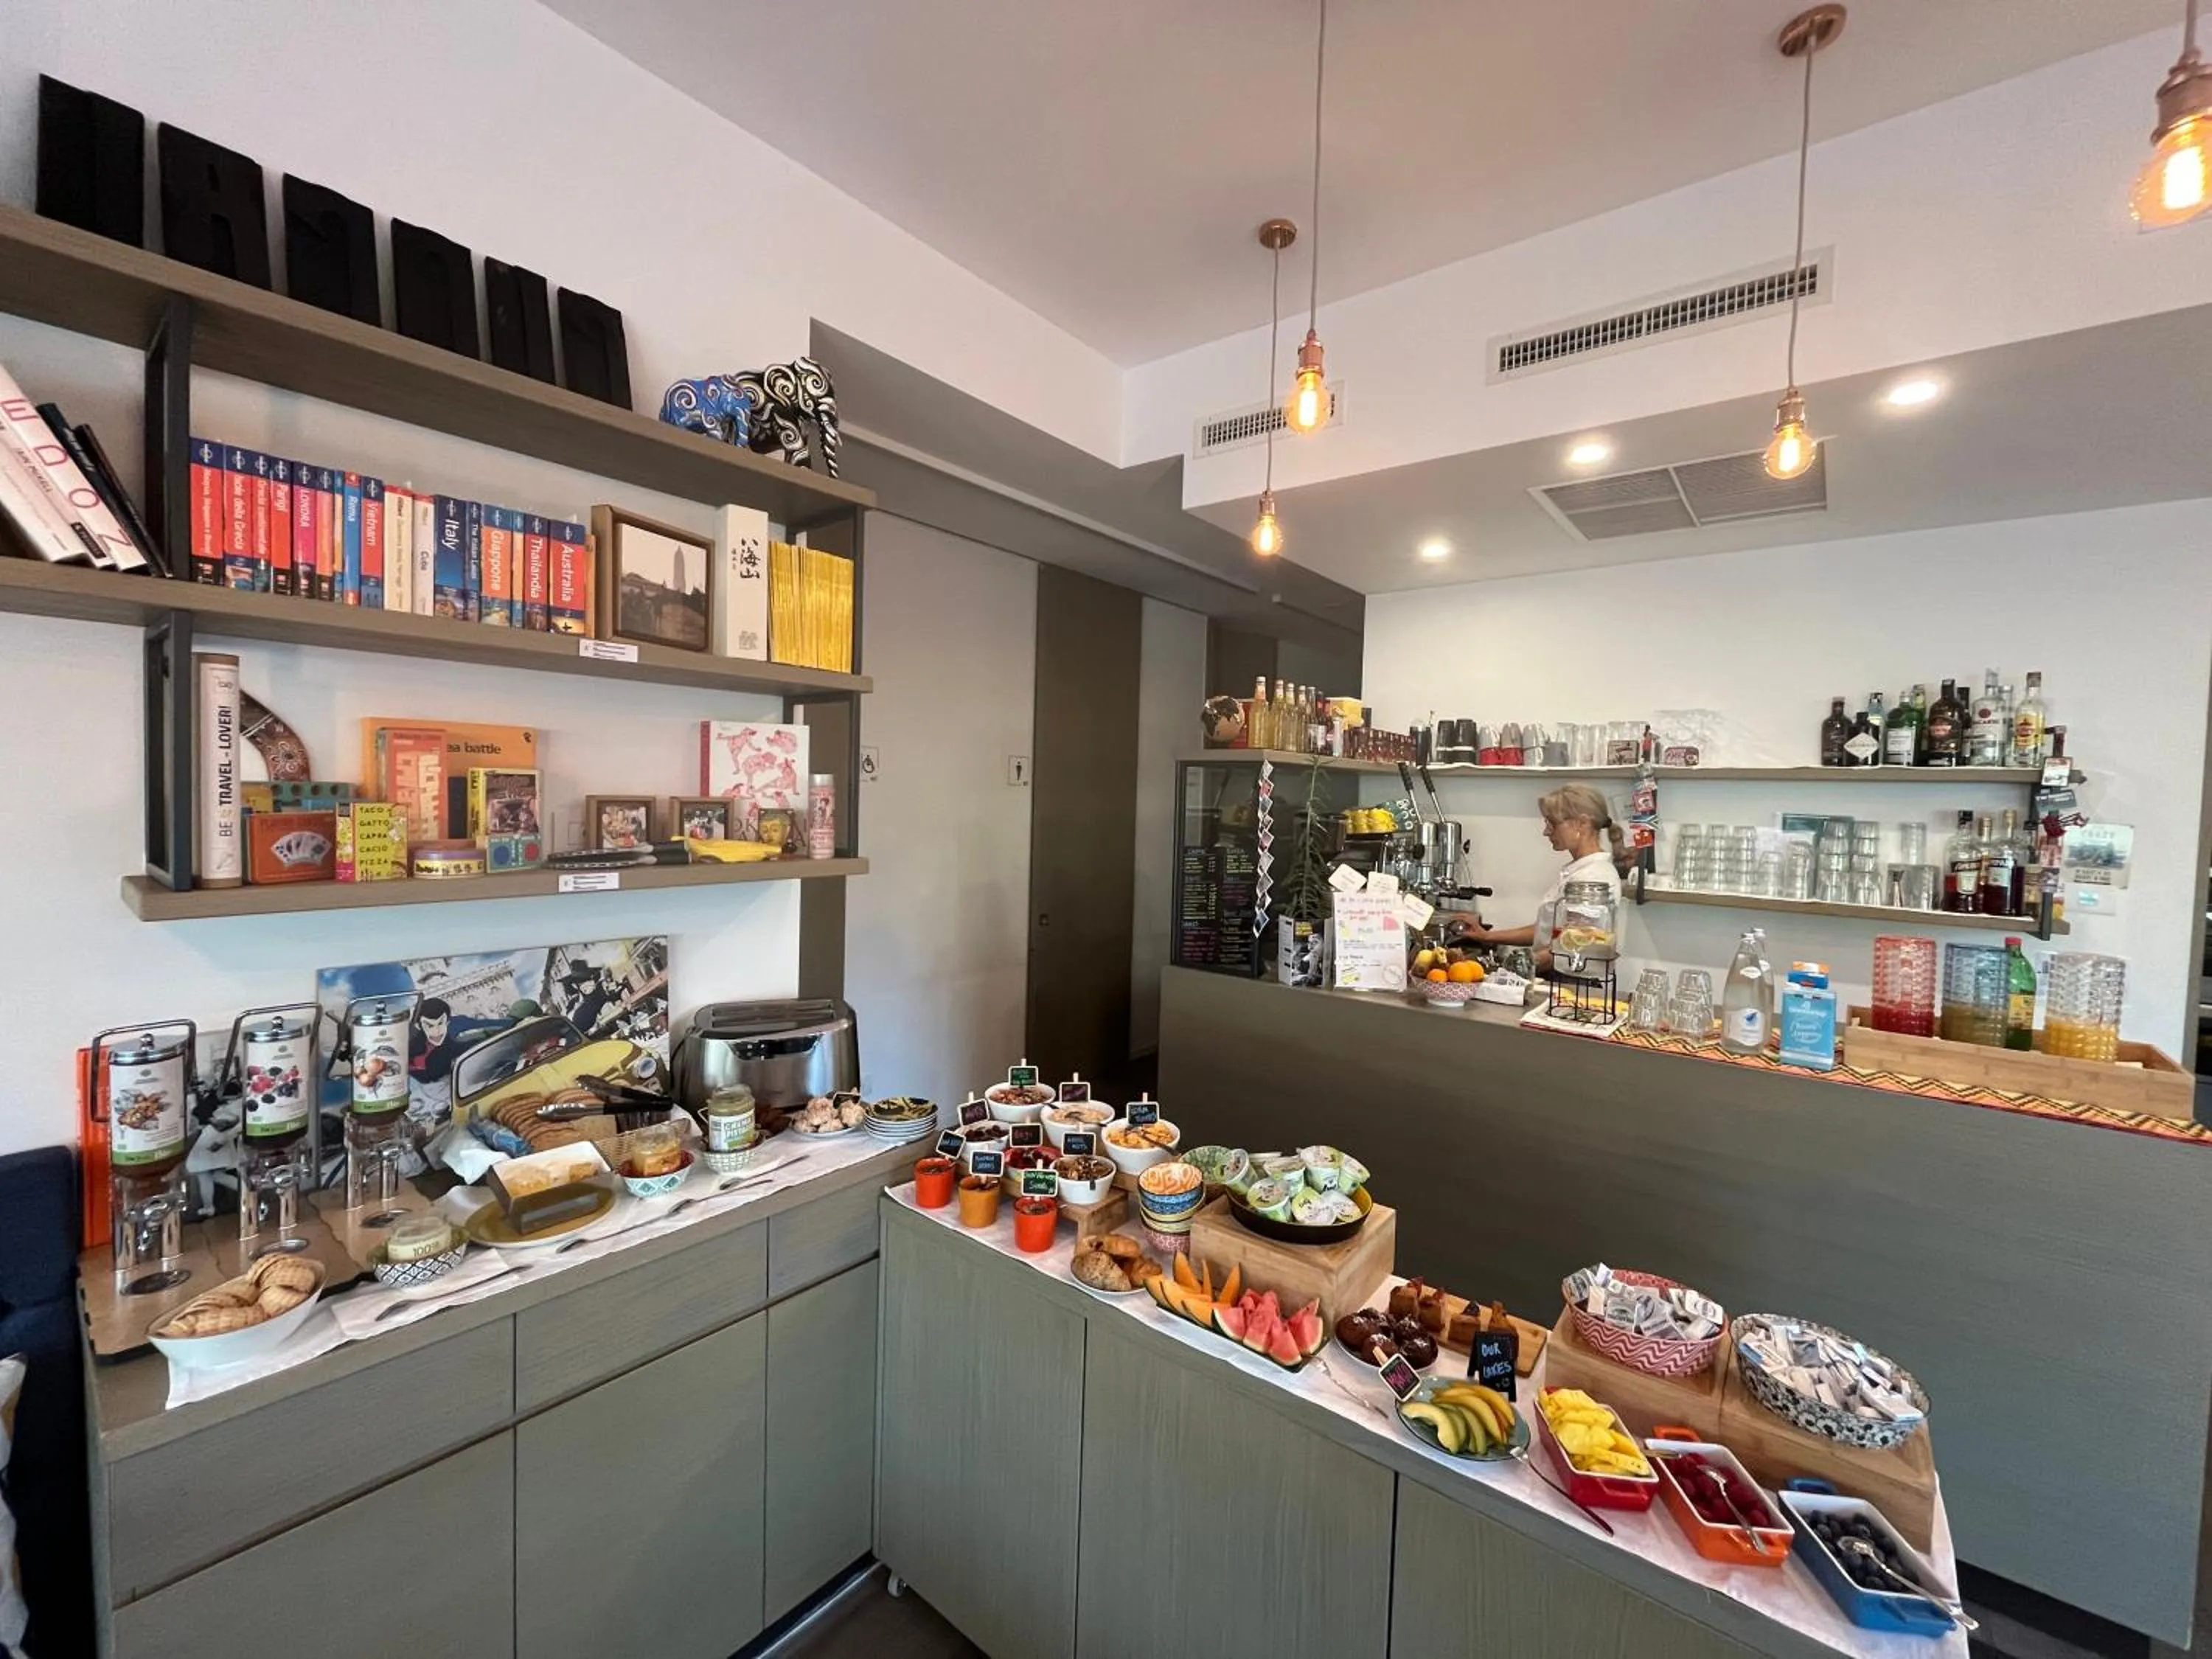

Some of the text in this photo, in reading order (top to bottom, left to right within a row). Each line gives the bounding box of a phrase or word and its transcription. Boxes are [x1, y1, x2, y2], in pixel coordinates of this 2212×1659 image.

[275, 484, 288, 511] Parigi
[300, 489, 310, 527] LONDRA
[366, 502, 379, 547] Vietnam
[442, 518, 460, 550] Italy
[491, 530, 505, 591] Giappone
[530, 538, 543, 599] Thailandia
[561, 544, 574, 602] Australia
[464, 741, 502, 754] battle
[219, 822, 233, 837] BE
[1481, 1342, 1501, 1357] OUR
